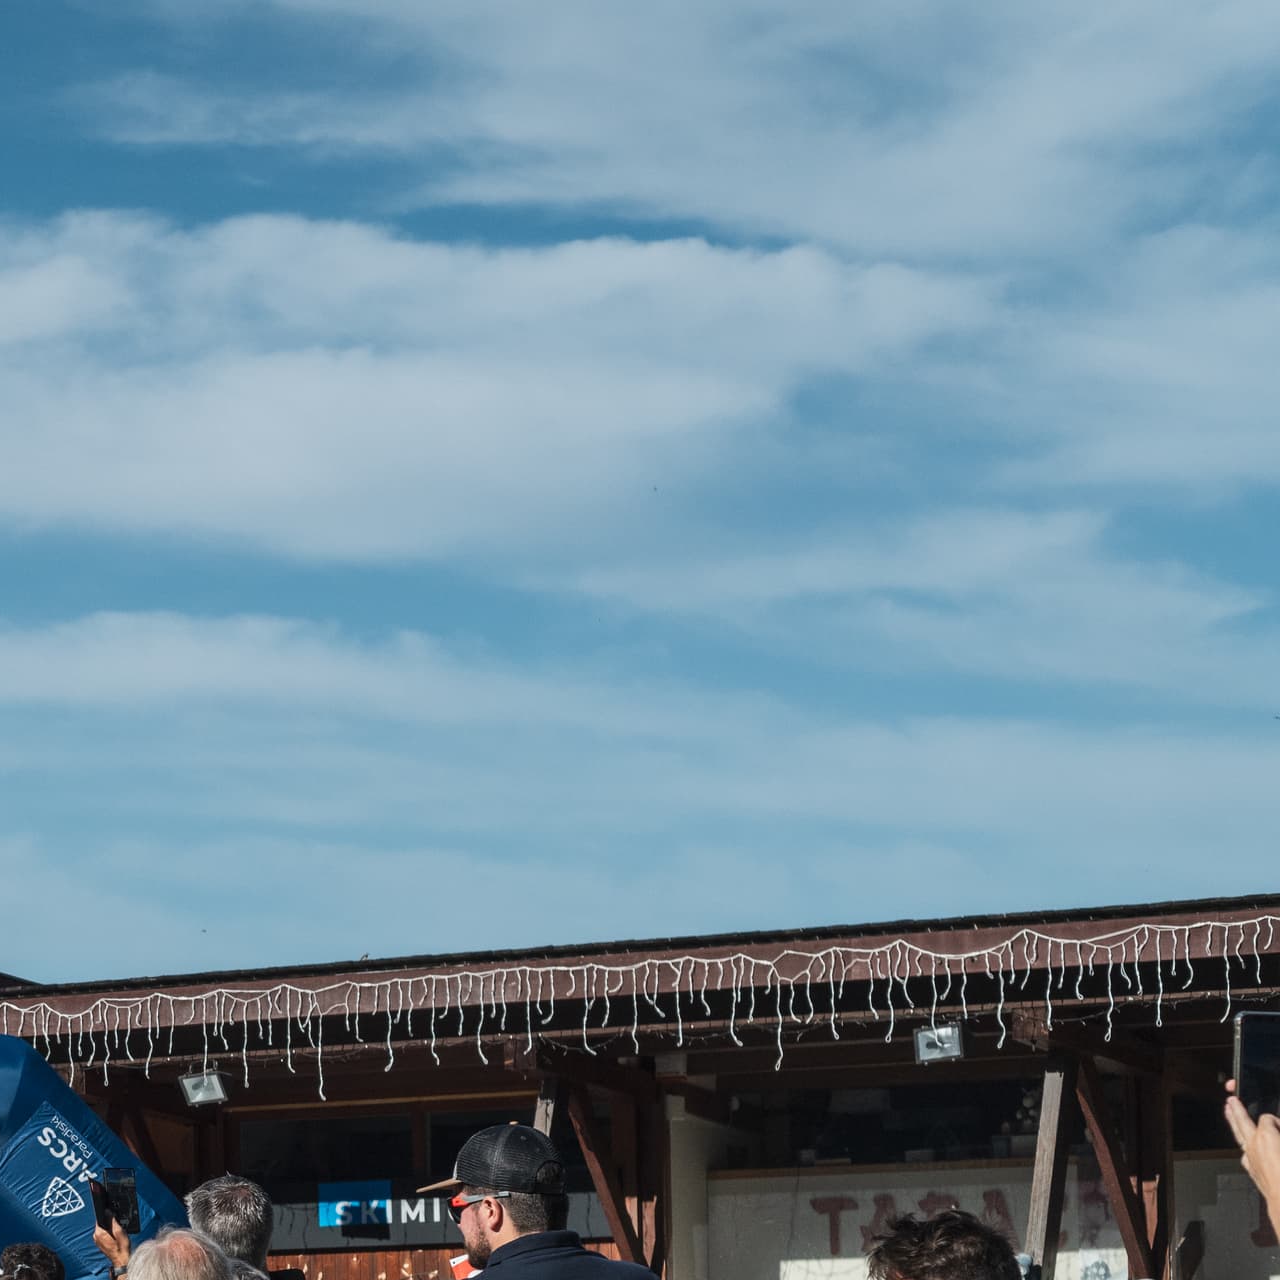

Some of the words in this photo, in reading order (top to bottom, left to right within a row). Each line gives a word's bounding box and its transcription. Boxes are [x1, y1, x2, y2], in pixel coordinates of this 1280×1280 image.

[37, 1127, 98, 1182] ARCS
[50, 1115, 93, 1159] Paradiski
[335, 1197, 443, 1226] SKIMI
